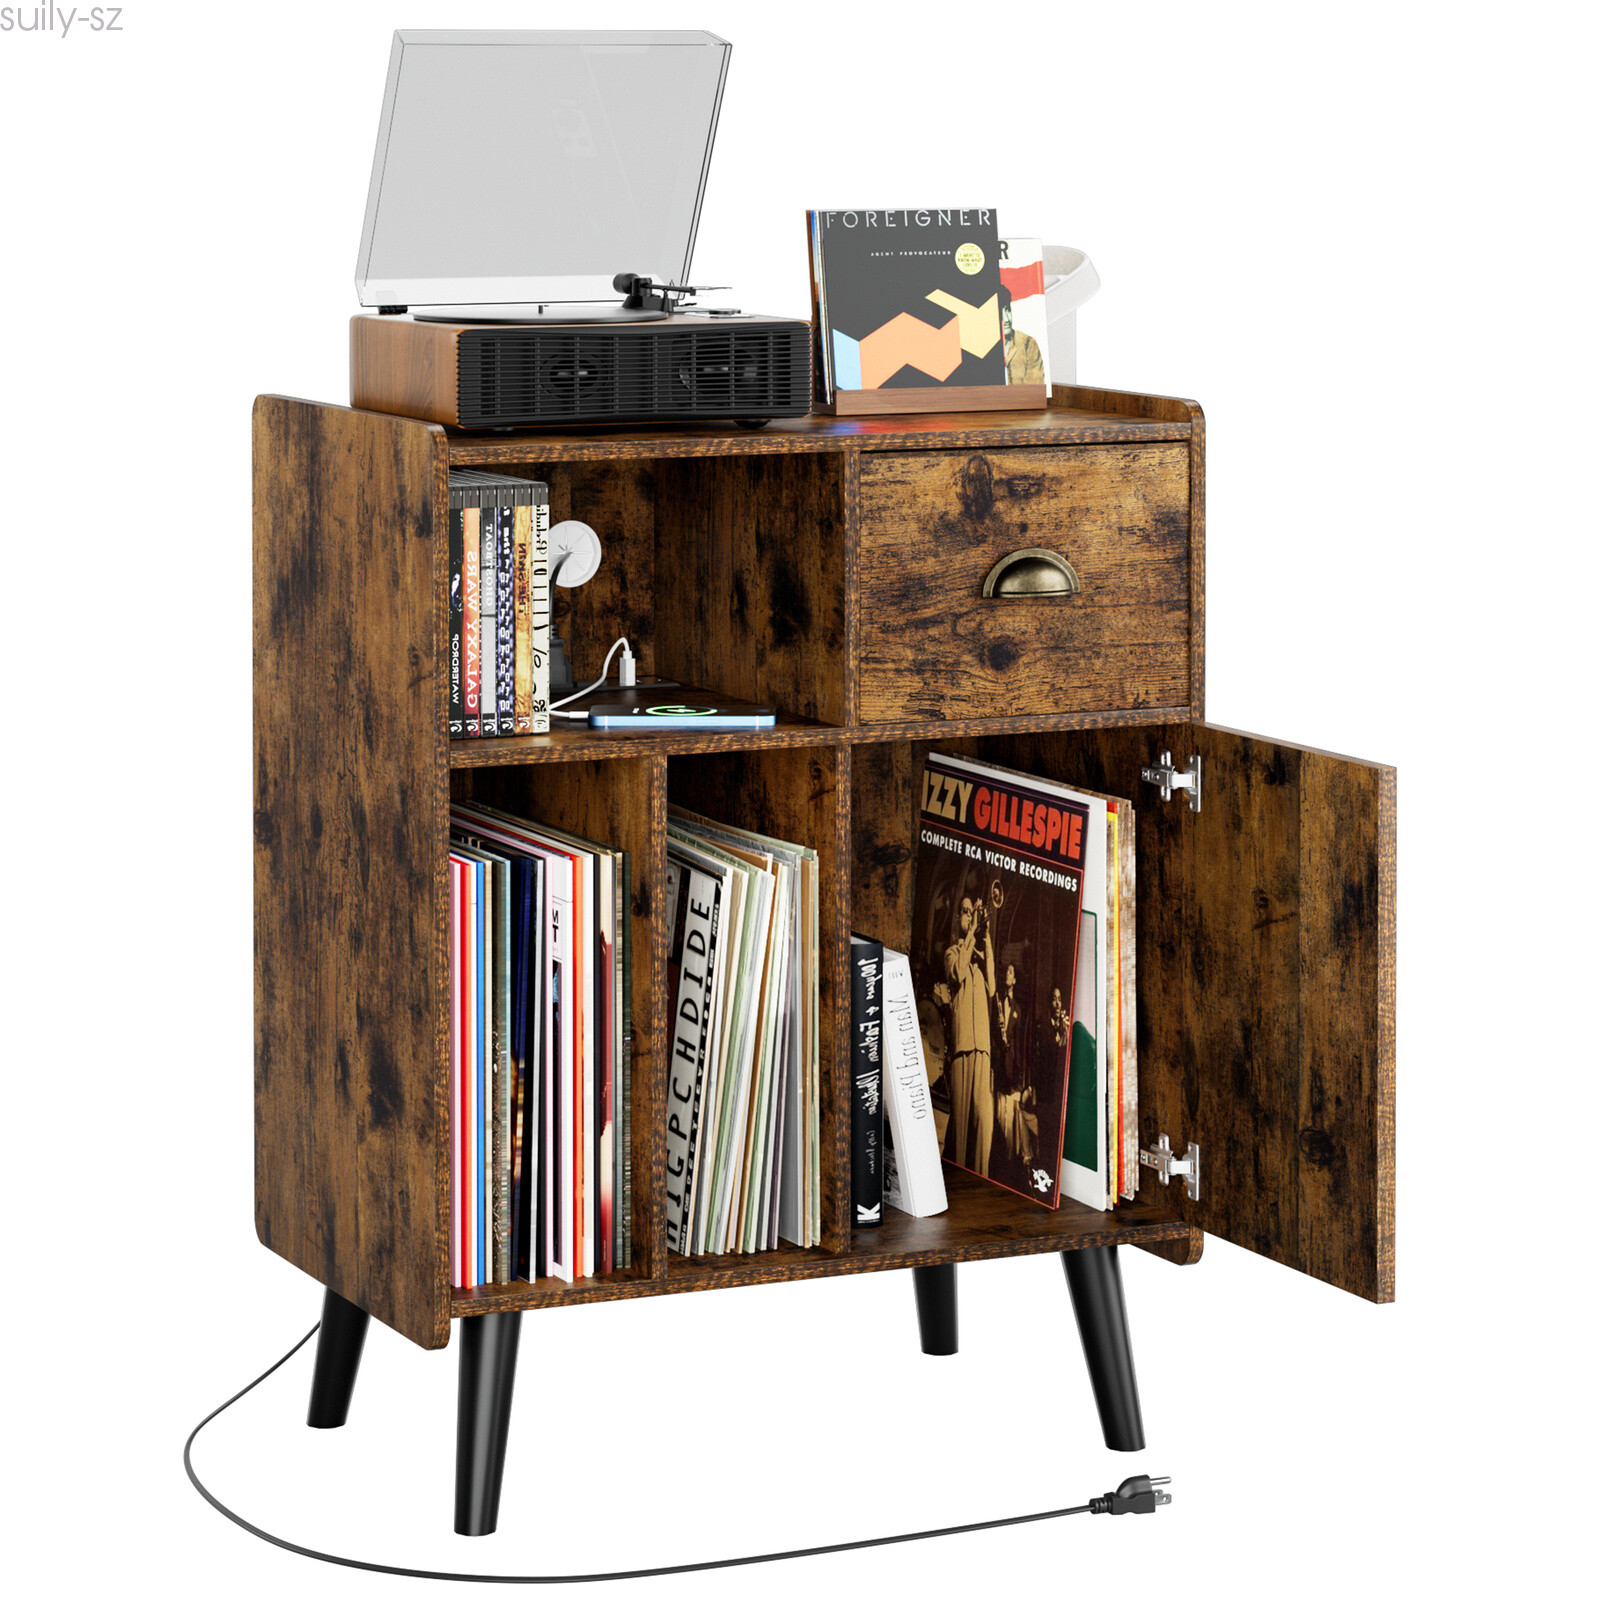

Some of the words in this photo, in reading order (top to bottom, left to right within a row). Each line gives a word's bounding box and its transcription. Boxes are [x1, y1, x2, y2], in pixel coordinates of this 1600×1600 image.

[826, 208, 991, 228] FOREIGNER
[920, 769, 974, 824] IZZY
[973, 786, 1083, 860] GILLESPIE
[920, 829, 963, 855] COMPLETE
[964, 843, 982, 861] RCA
[984, 850, 1017, 873] VICTOR
[1019, 861, 1078, 893] RECORDINGS
